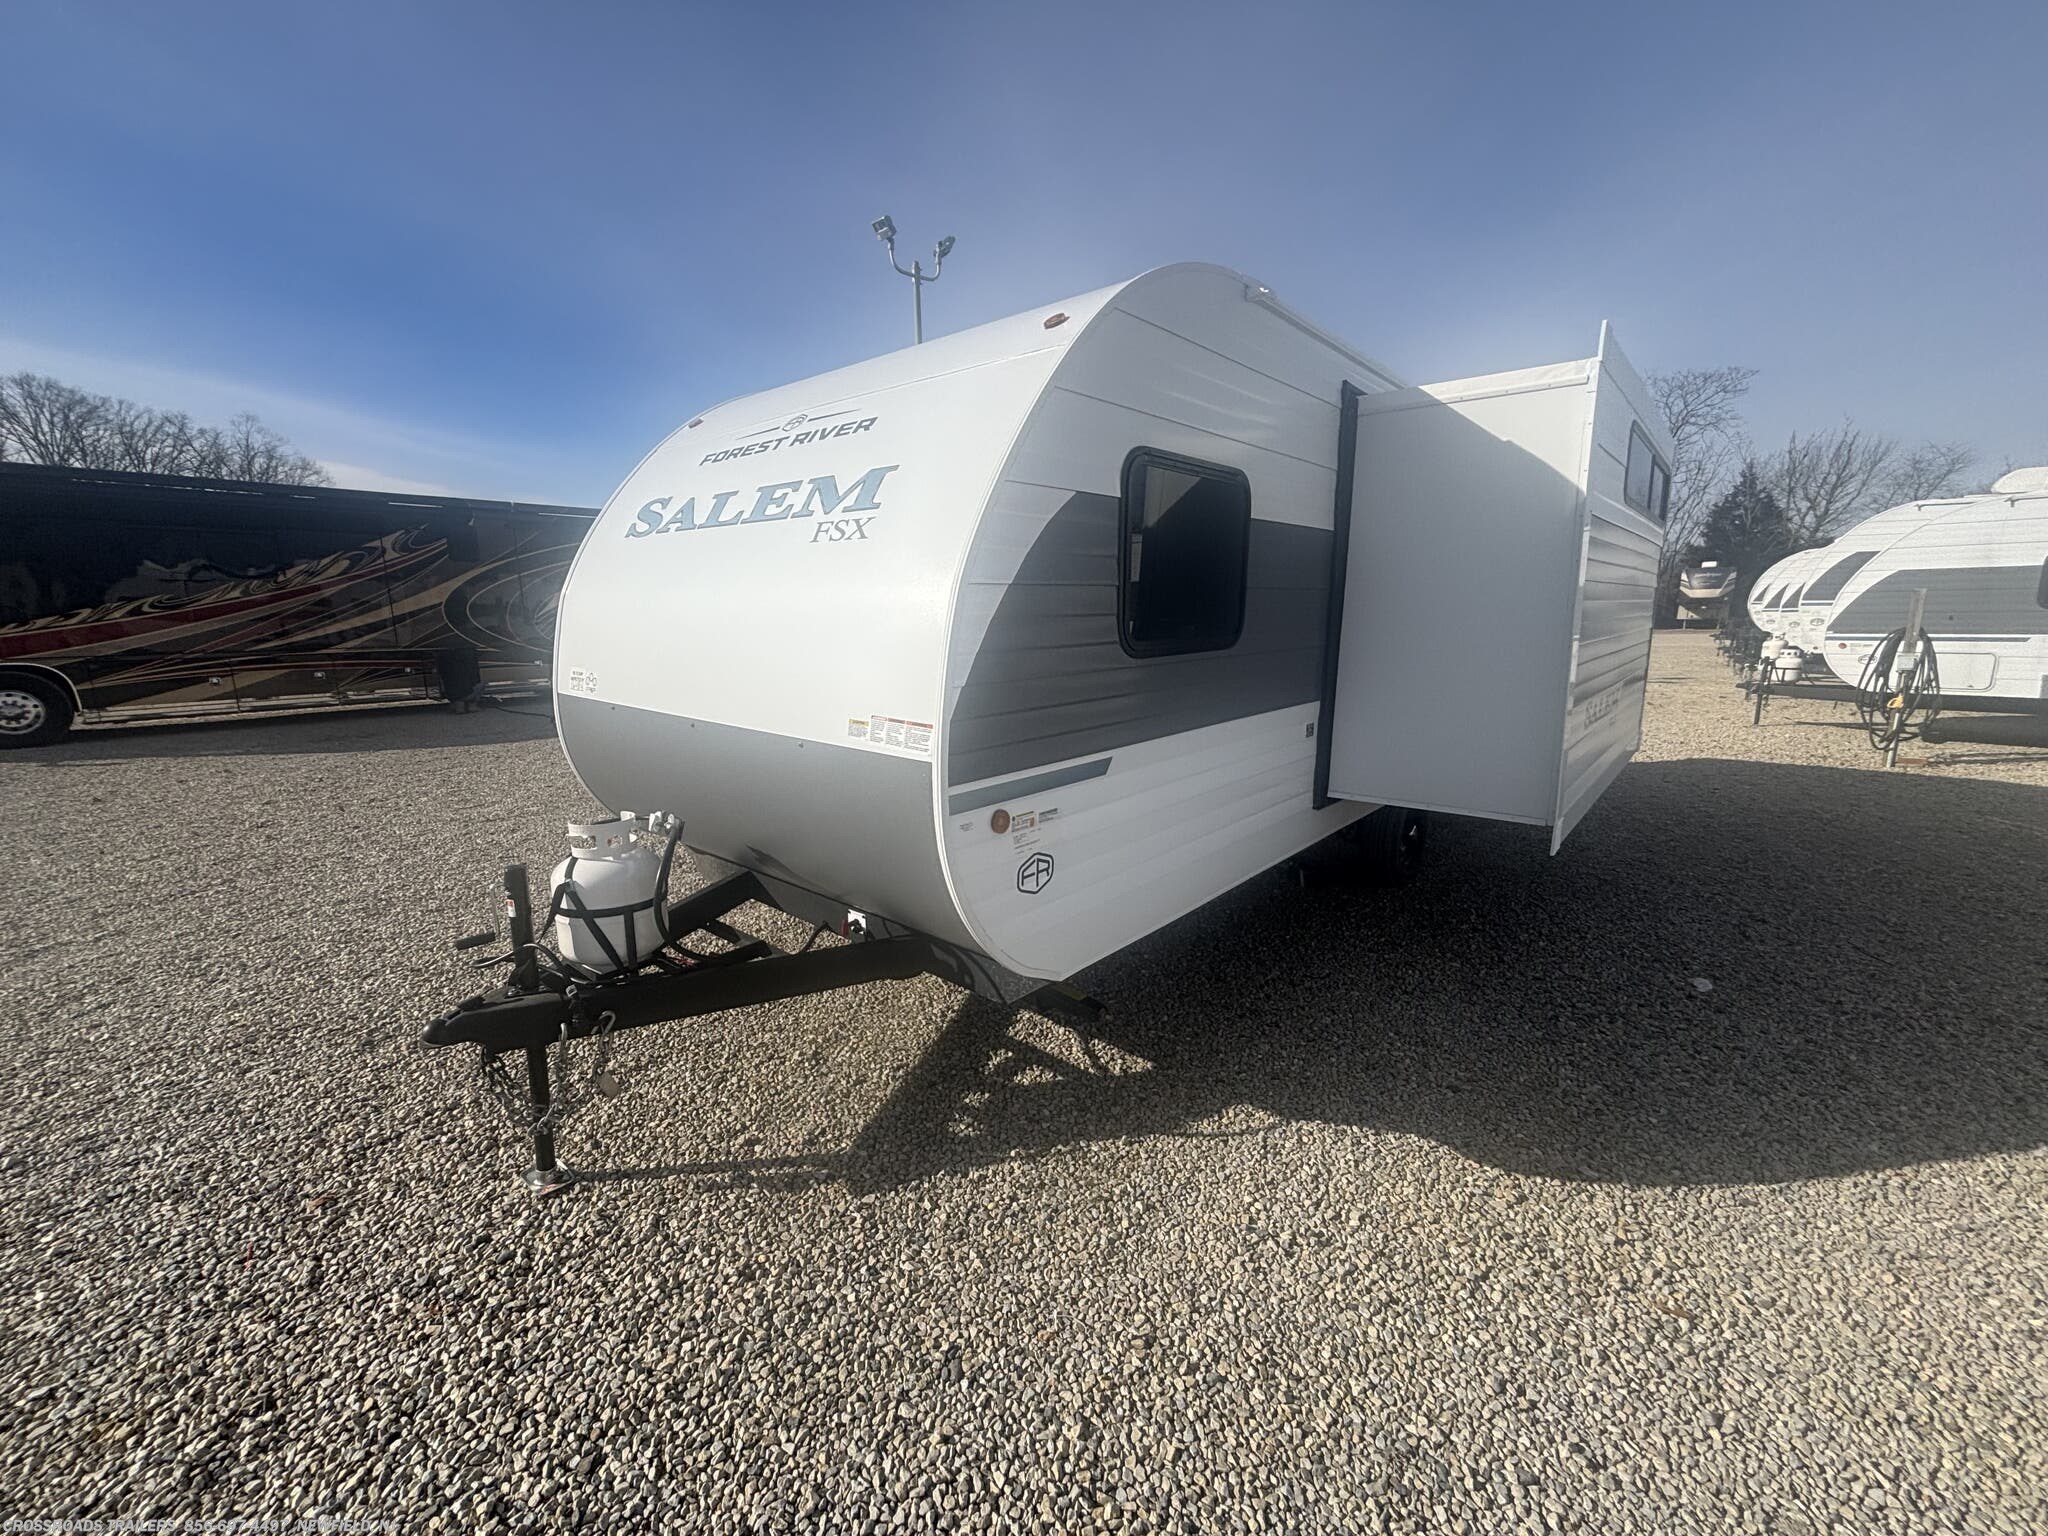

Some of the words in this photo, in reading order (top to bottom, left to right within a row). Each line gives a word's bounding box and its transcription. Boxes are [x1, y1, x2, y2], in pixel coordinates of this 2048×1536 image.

[699, 435, 791, 466] FOREST
[789, 416, 878, 447] RIVER
[625, 464, 900, 539] SALEM
[809, 517, 877, 543] FSX
